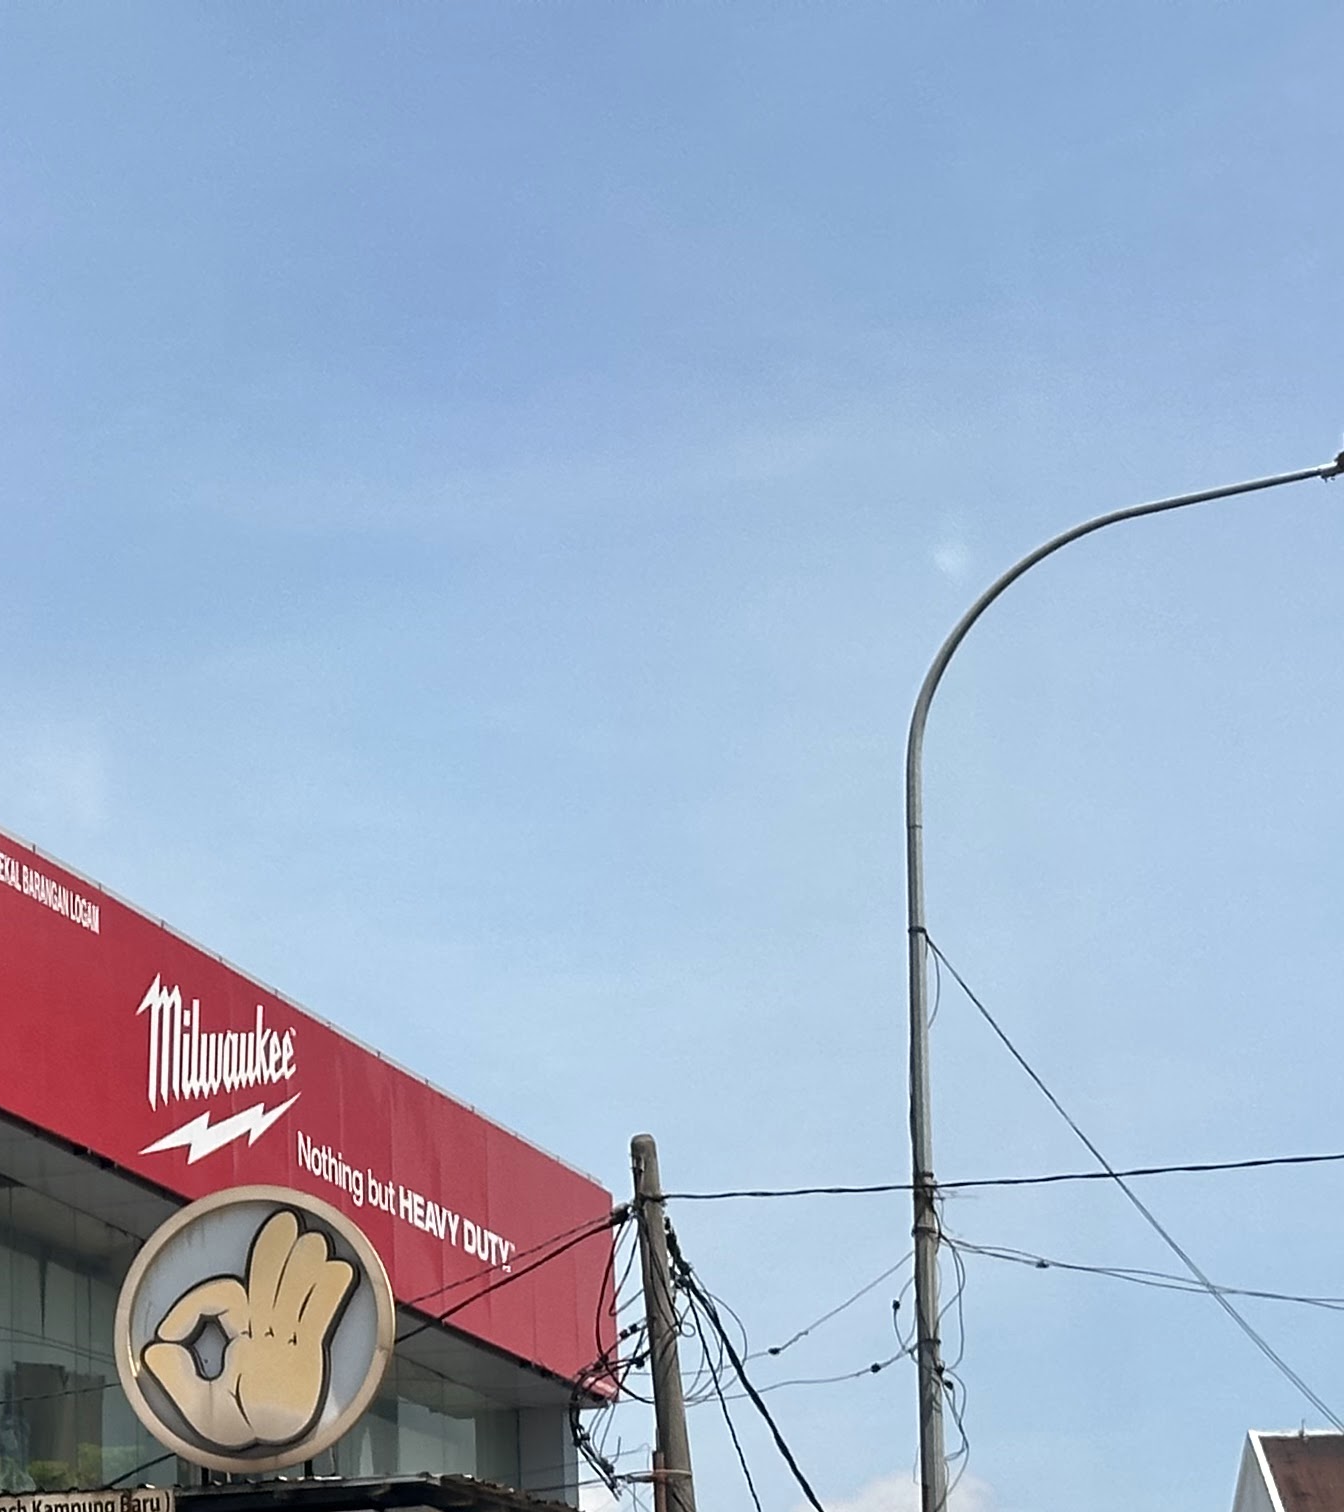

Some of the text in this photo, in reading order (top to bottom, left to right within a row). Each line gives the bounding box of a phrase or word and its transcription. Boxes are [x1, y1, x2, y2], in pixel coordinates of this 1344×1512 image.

[23, 864, 69, 918] BARANGAN
[70, 890, 100, 934] LOGAM
[136, 972, 297, 1112] Milwaukee
[297, 1130, 364, 1207] Nothing
[367, 1168, 396, 1216] but
[398, 1185, 460, 1246] HEAVY
